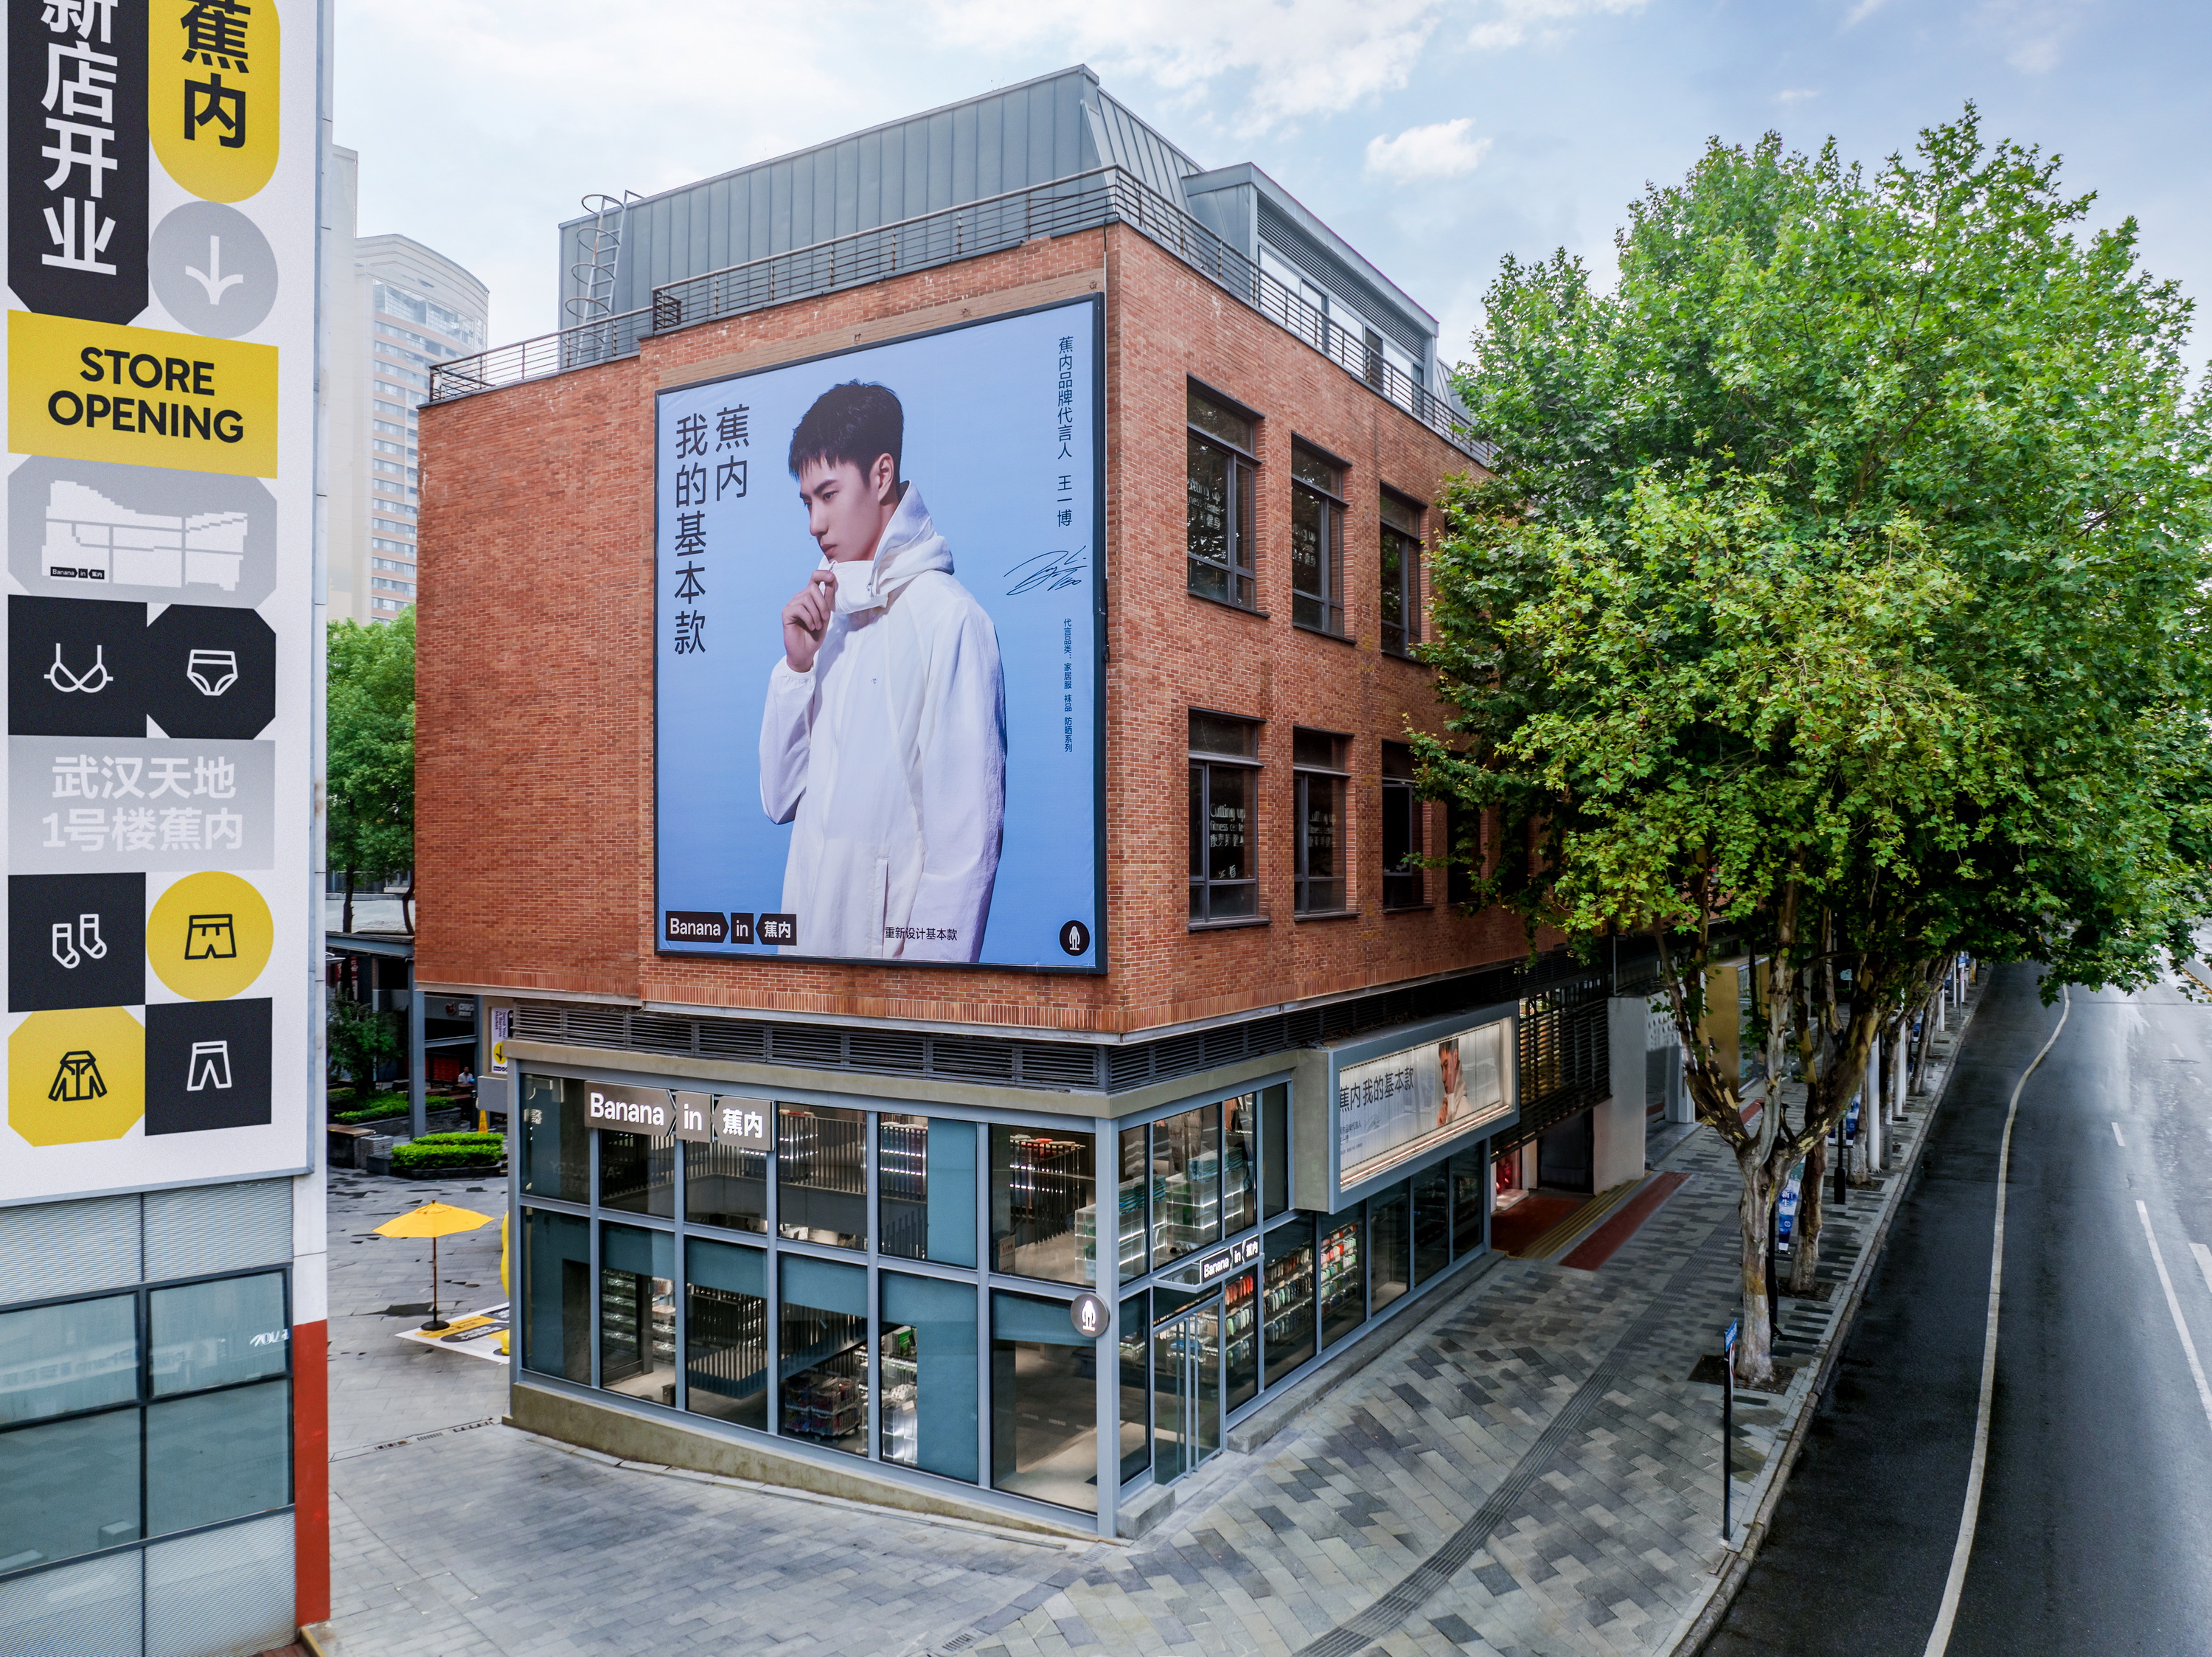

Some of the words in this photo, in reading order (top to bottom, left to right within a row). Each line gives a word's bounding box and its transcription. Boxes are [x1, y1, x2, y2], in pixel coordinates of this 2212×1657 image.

[181, 0, 251, 148] 蕉内
[80, 346, 215, 396] STORE
[48, 390, 244, 444] OPENING
[1057, 336, 1074, 459] 蕉内品牌代言人
[715, 403, 750, 501] 蕉内
[1057, 474, 1072, 527] 王一博
[674, 413, 709, 655] 我的基本款
[1064, 694, 1072, 712] 袜品
[1064, 717, 1072, 752] 防晒系列
[52, 754, 237, 800] 武汉天地
[43, 807, 243, 852] 1号楼蕉内
[1237, 808, 1246, 822] up
[670, 918, 721, 937] Banana
[736, 920, 748, 937] in
[763, 921, 791, 939] 蕉内
[884, 926, 958, 942] 重新设计基本款
[1340, 1082, 1360, 1113] 蕉内
[1363, 1065, 1414, 1106] 我的基本款
[590, 1092, 664, 1126] Banana
[684, 1103, 702, 1131] in
[723, 1108, 763, 1139] 蕉内
[1203, 1257, 1229, 1278] Banana
[1234, 1250, 1241, 1263] in
